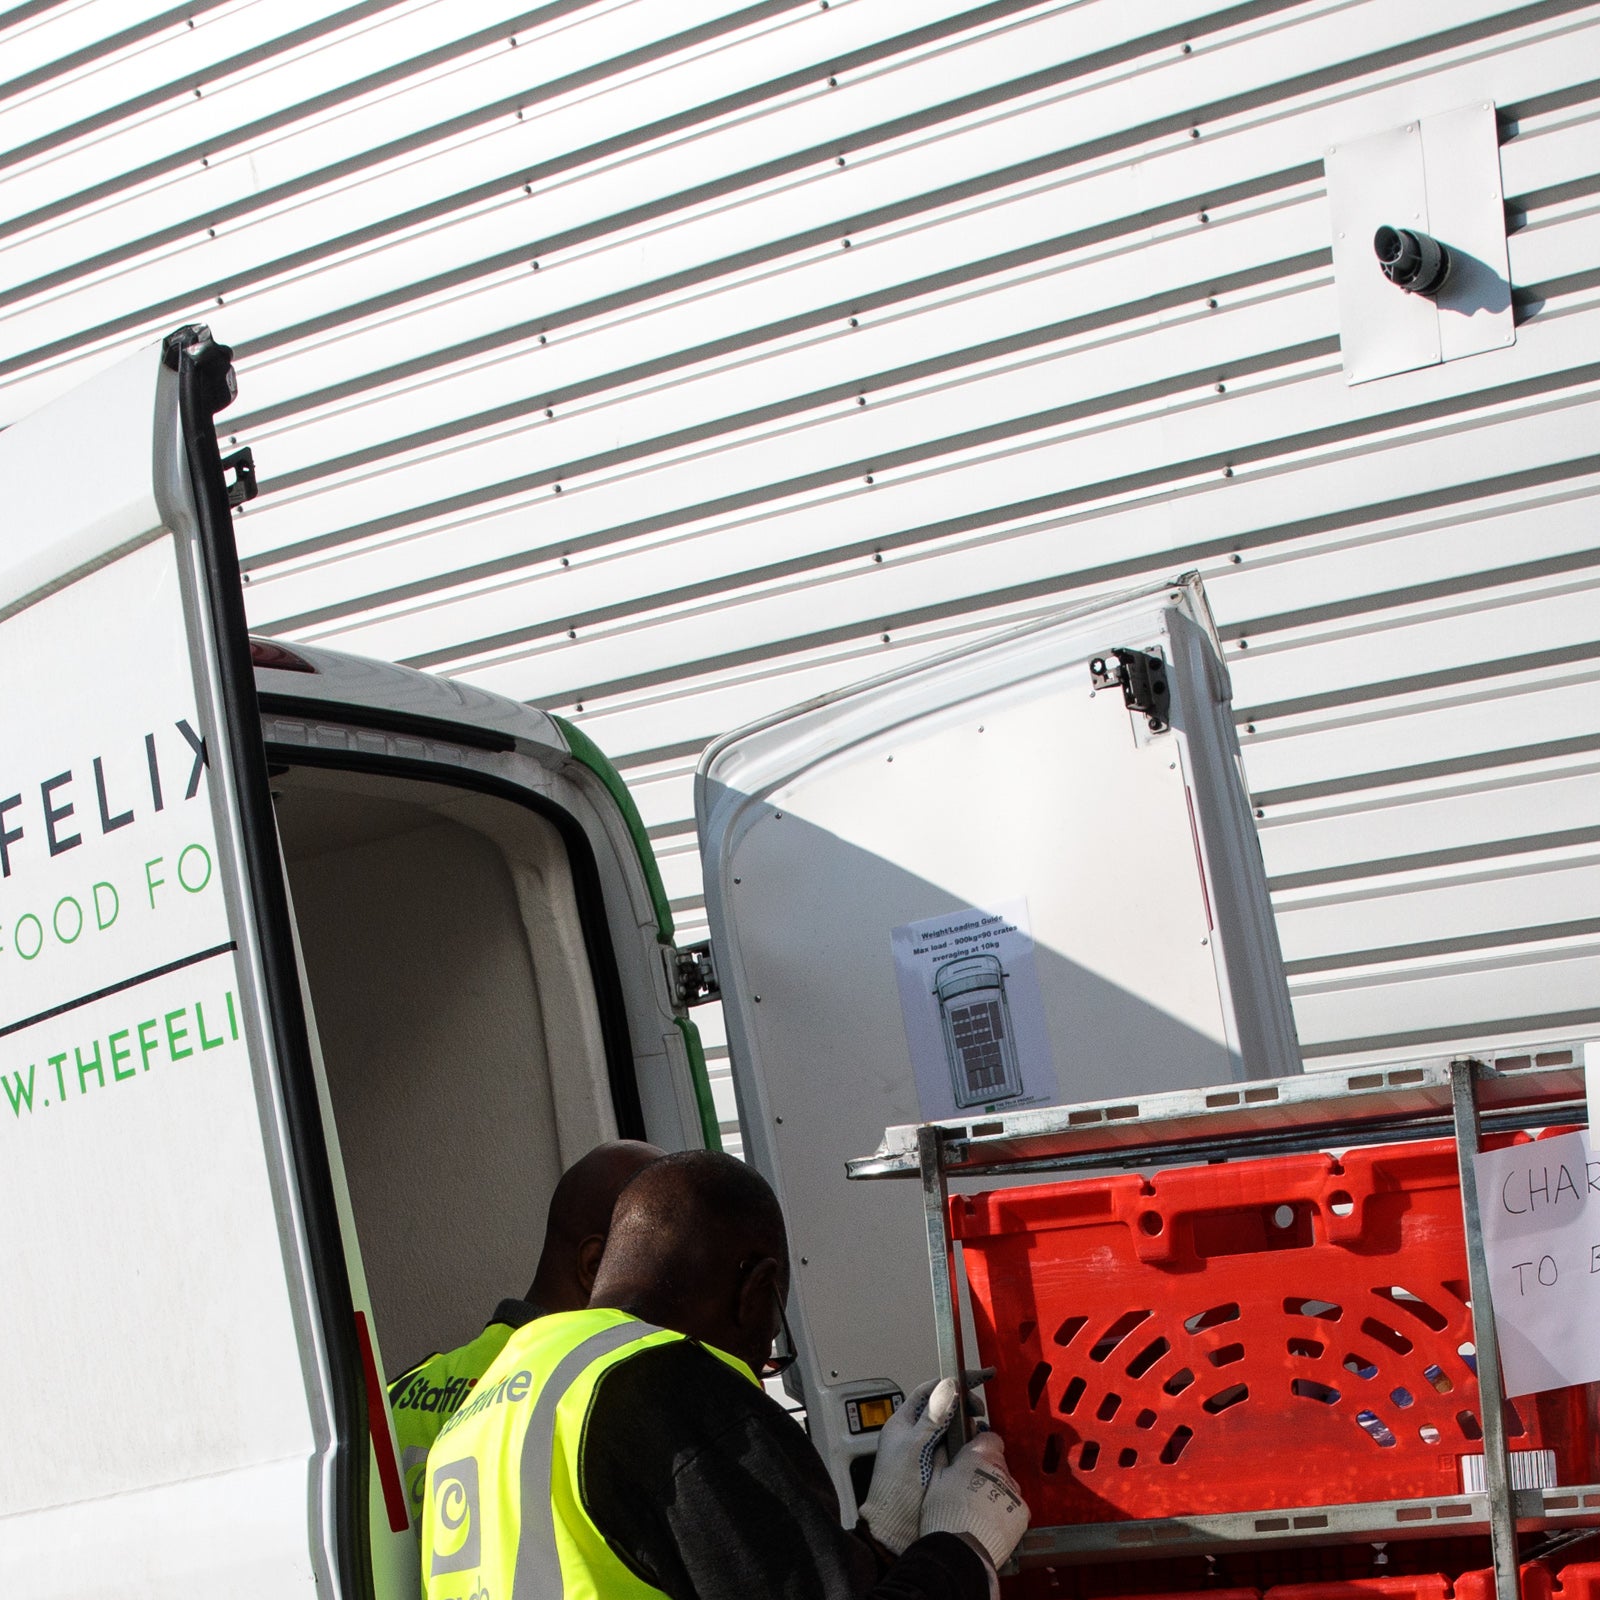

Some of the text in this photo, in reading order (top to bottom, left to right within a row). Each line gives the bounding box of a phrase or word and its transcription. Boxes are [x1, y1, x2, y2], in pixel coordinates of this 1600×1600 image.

[145, 844, 212, 909] FO
[913, 947, 929, 956] Max
[930, 941, 948, 952] load
[993, 925, 1018, 937] crates
[932, 941, 1000, 963] averaging at 10kg
[1512, 1255, 1558, 1296] TO
